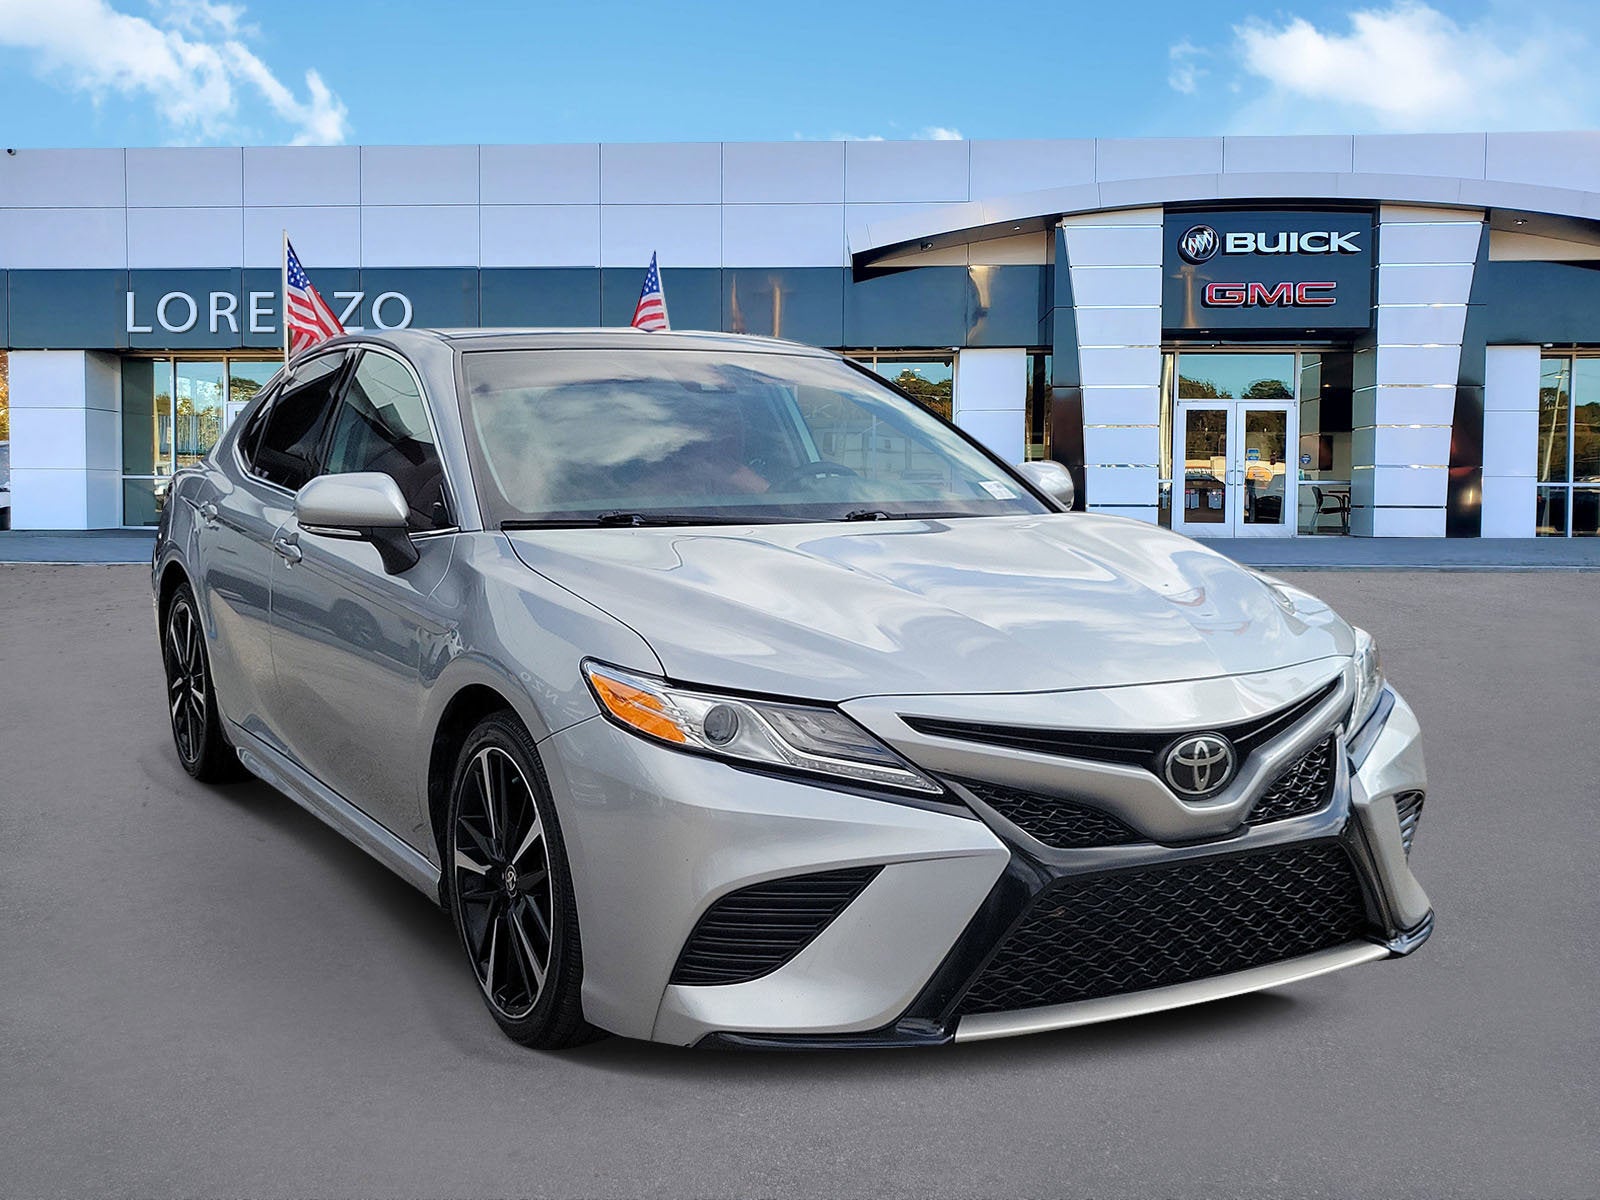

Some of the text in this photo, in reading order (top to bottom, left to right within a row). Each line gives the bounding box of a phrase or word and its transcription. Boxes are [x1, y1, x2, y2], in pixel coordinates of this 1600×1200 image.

[1225, 231, 1362, 253] BUICK
[1203, 282, 1336, 305] GMC
[126, 291, 413, 332] LOREZO
